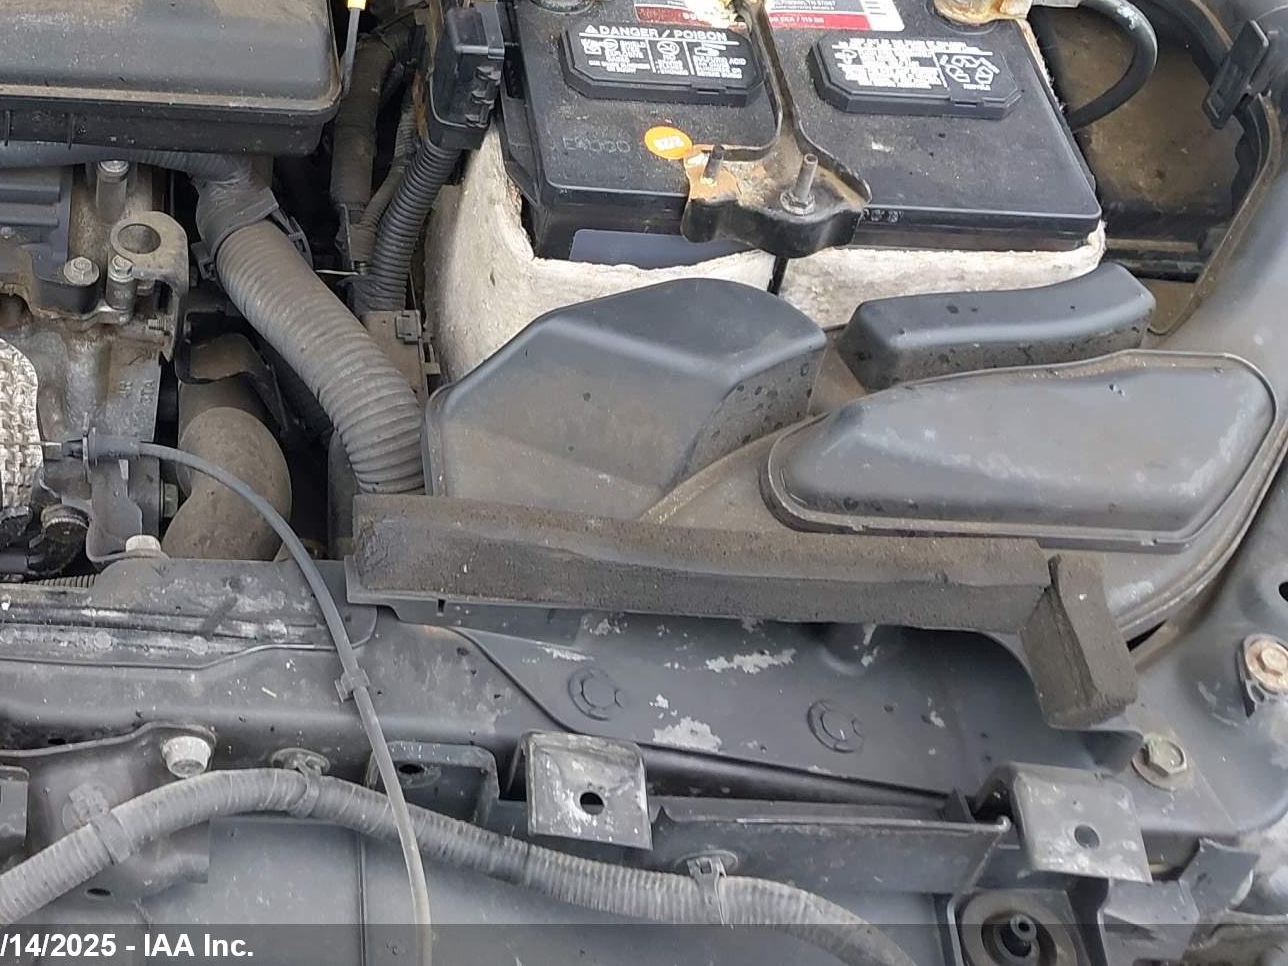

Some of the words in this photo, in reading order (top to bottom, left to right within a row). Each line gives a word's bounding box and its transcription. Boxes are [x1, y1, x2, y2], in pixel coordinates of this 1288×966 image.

[598, 25, 659, 38] DANGER
[673, 30, 728, 42] POISON
[728, 57, 747, 66] ACID
